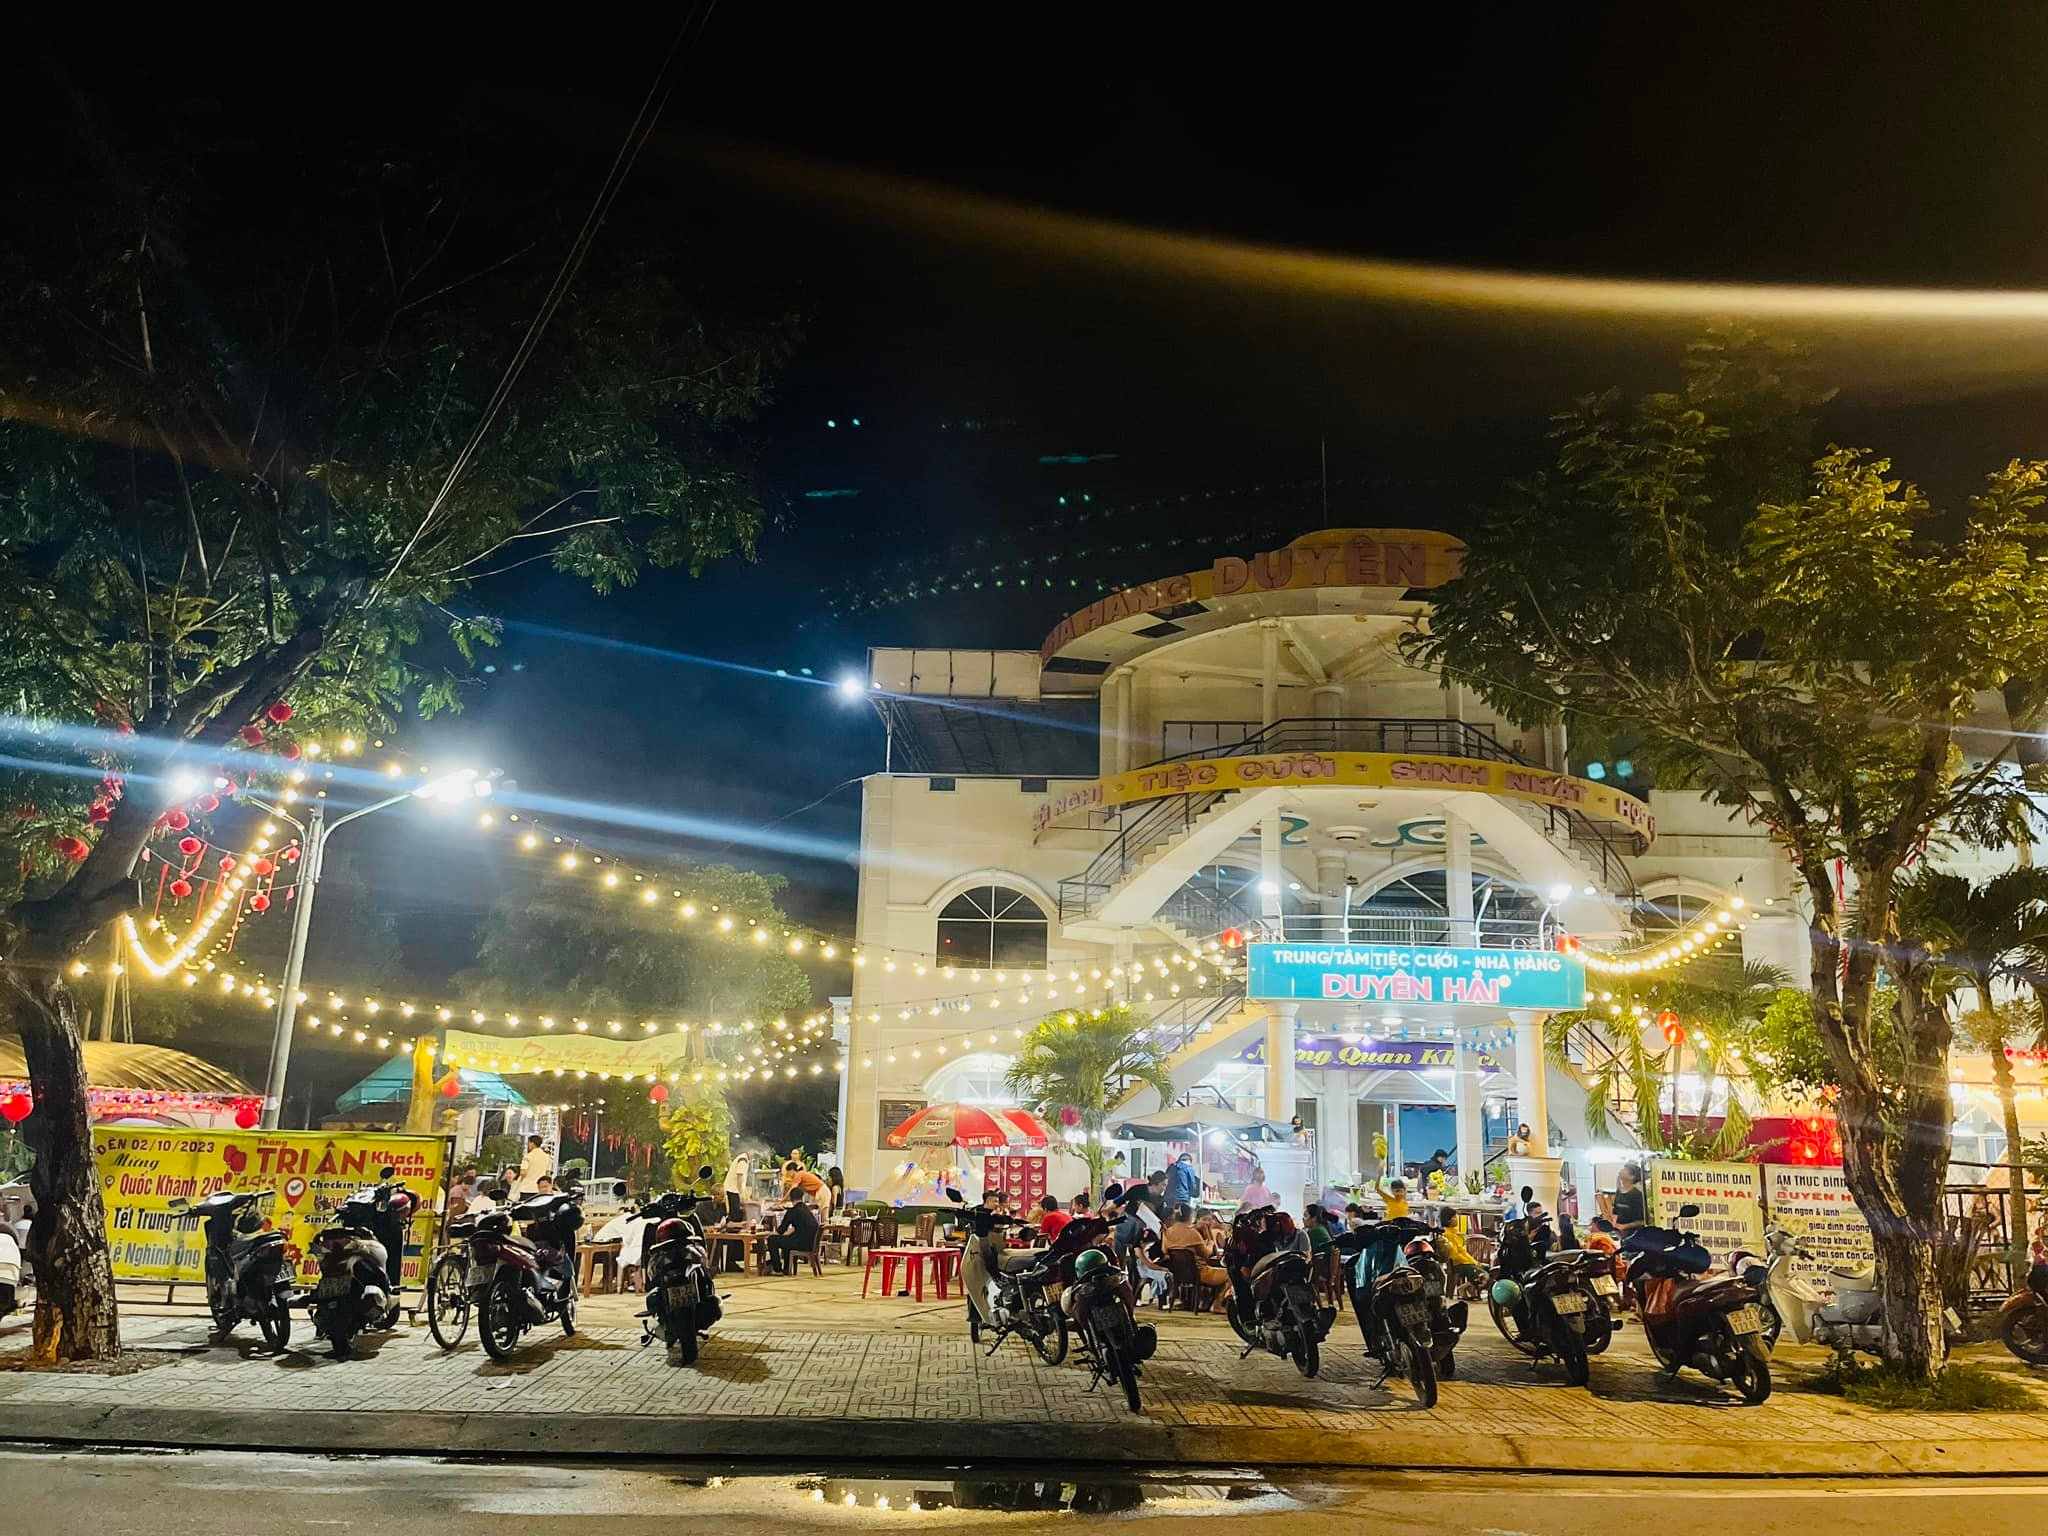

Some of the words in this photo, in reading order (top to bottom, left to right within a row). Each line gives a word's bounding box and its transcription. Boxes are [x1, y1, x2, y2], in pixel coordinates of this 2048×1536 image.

[1211, 534, 1426, 598] DUYÊN
[1137, 763, 1218, 793] TIỆC
[1390, 760, 1489, 785] SINH
[1272, 949, 1331, 966] TRUNG
[1333, 949, 1371, 967] TÂM
[1373, 950, 1411, 969] TIỆC
[1321, 969, 1433, 1001] DUYÊN
[1442, 970, 1500, 1003] HẢI
[1337, 1046, 1414, 1066] Quan
[255, 1148, 310, 1175] TRI
[313, 1140, 368, 1176] ÂN
[119, 1171, 153, 1197] Quốc
[155, 1174, 198, 1197] Khánh
[113, 1203, 133, 1229] Tết
[136, 1208, 174, 1233] Trung
[125, 1241, 172, 1268] Nghinh
